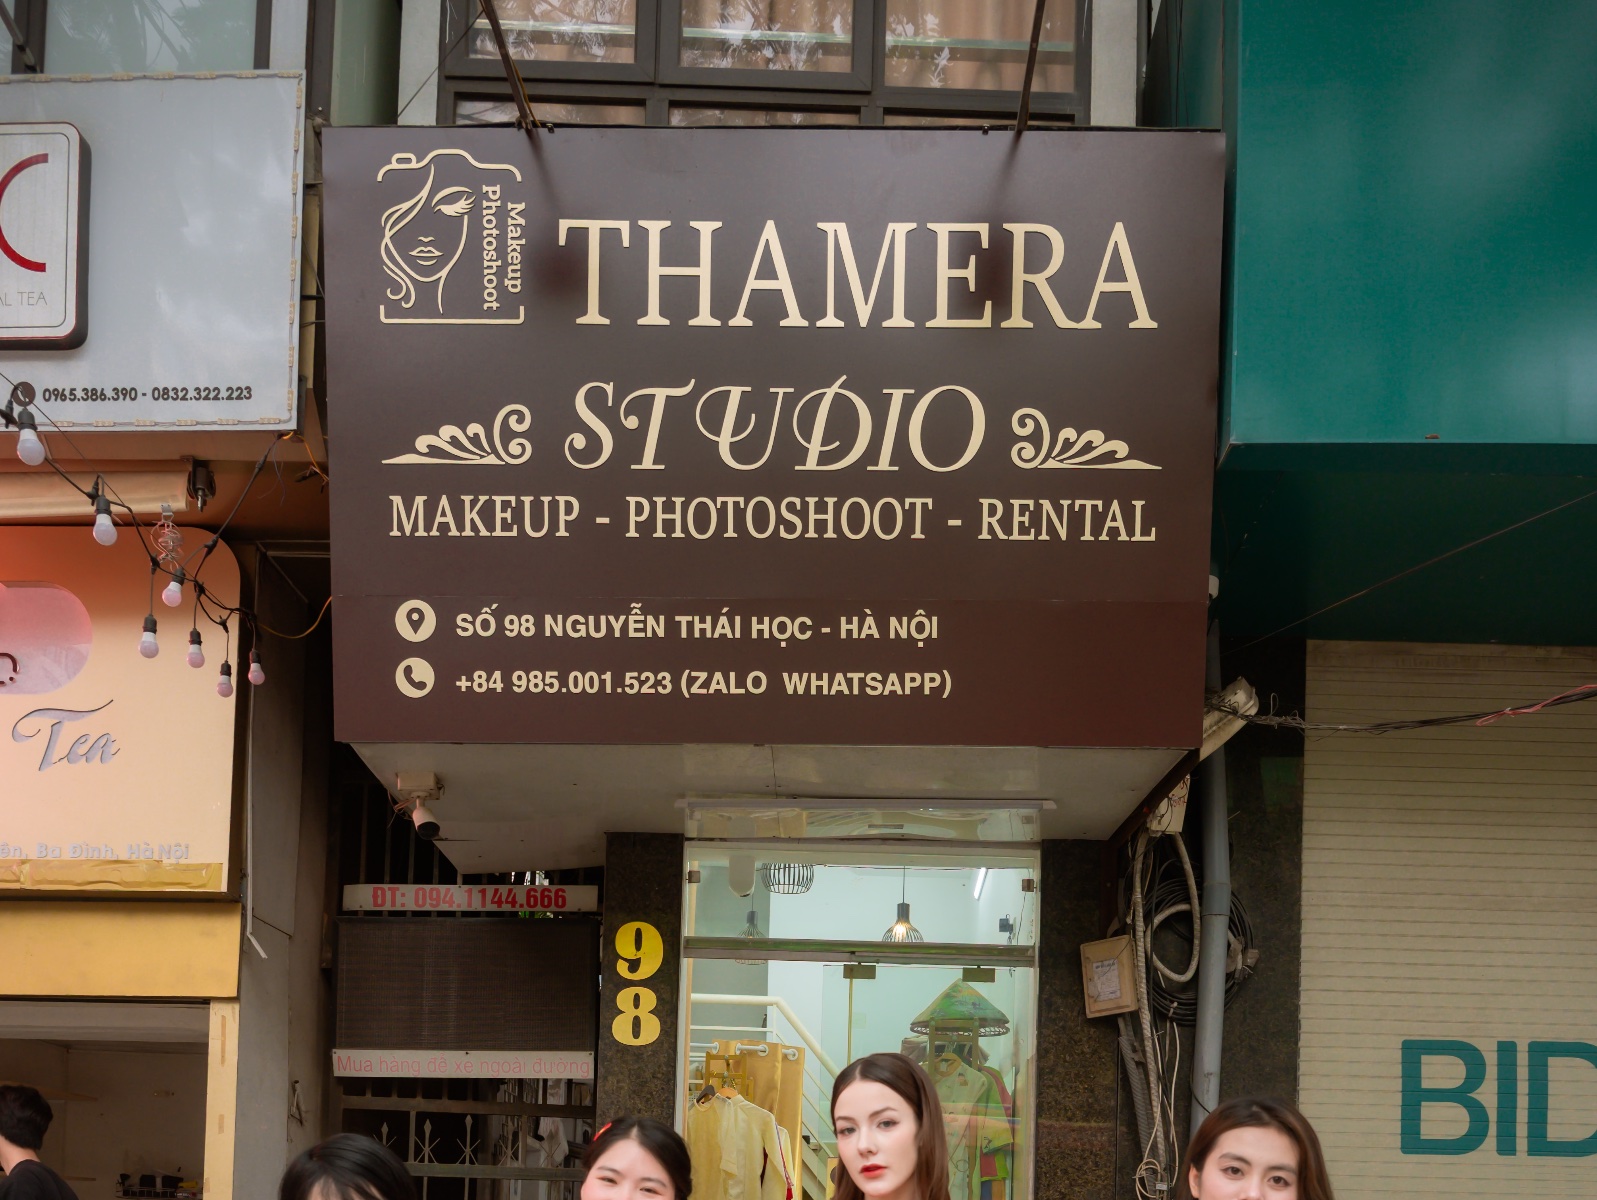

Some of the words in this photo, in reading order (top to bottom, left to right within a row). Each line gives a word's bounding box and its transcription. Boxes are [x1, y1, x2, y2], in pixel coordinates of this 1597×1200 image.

[482, 184, 502, 311] Photoshoot
[504, 202, 526, 294] Makeup
[557, 218, 1159, 330] THAMERA
[16, 291, 48, 306] TEA
[42, 387, 138, 402] 0965.386.390
[151, 386, 253, 401] 0832.322.223
[564, 374, 987, 473] STUDIO
[389, 495, 580, 539] MAKEUP
[625, 496, 933, 541] PHOTOSHOOT
[978, 498, 1157, 542] RENTAL
[455, 603, 500, 638] SỐ
[504, 614, 535, 639] 98
[544, 602, 666, 639] NGUYỄN
[675, 607, 741, 640] THÁI
[751, 615, 813, 648] HỌC
[840, 608, 880, 640] HÀ
[889, 609, 939, 648] NỘI
[455, 670, 504, 694] +84
[511, 670, 673, 696] 985.001.523
[680, 670, 768, 699] (ZALO
[782, 670, 952, 700] WHATSAPP)
[12, 699, 121, 771] Tea
[36, 843, 61, 859] Ba
[70, 842, 118, 860] Đình,
[127, 842, 154, 860] Hà
[158, 842, 190, 864] Nội
[371, 886, 406, 908] ĐT:
[413, 887, 567, 909] 094.1144.666
[337, 1055, 374, 1073] Mua
[379, 1055, 421, 1077] hàng
[427, 1052, 448, 1073] để
[454, 1060, 474, 1074] xe
[479, 1056, 527, 1077] ngoài
[532, 1057, 591, 1078] đường
[1400, 1039, 1597, 1158] BID
